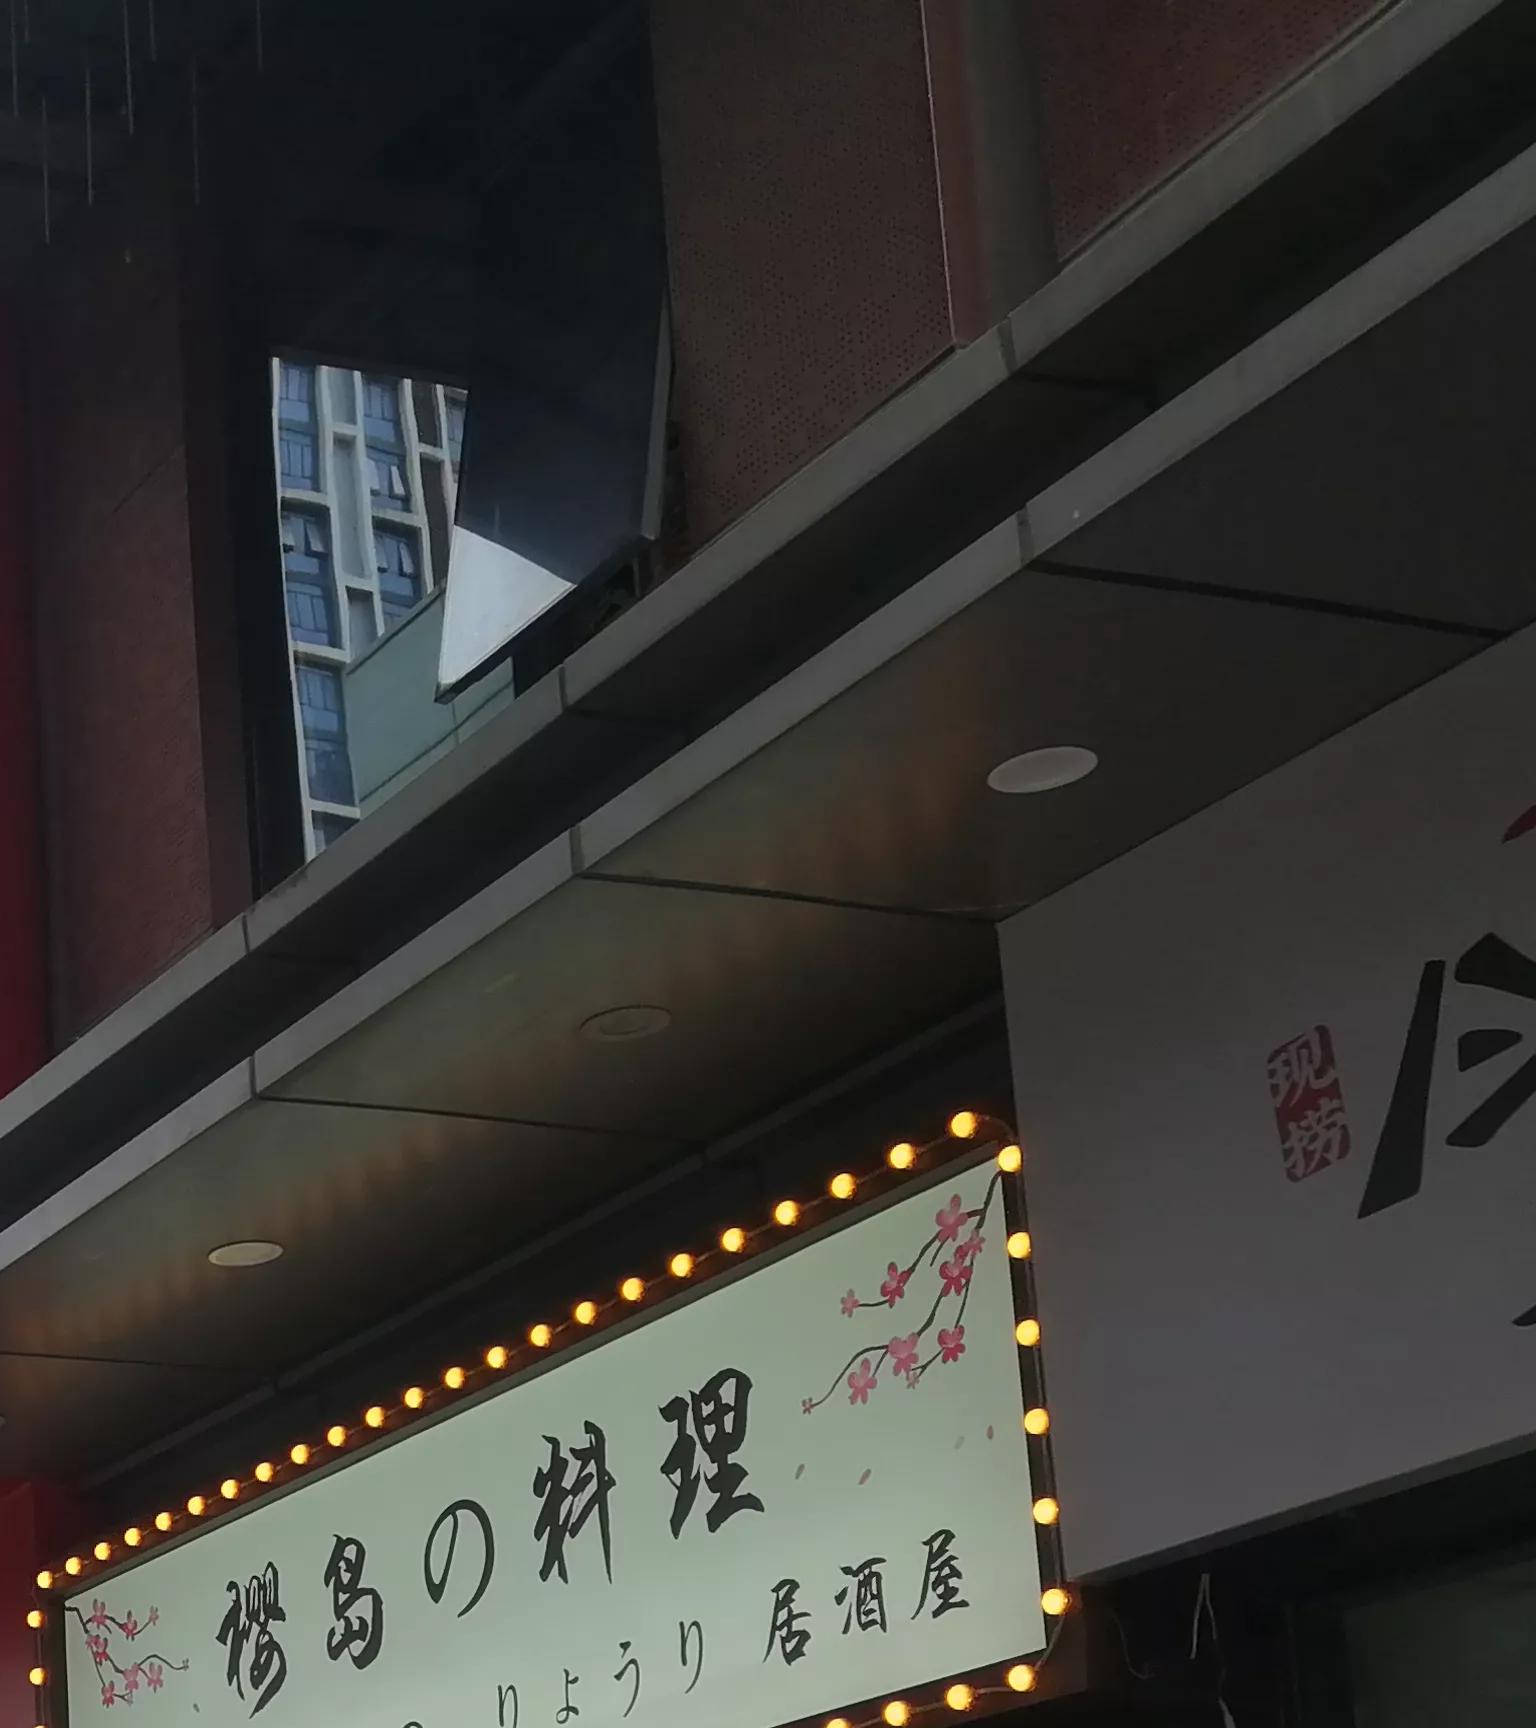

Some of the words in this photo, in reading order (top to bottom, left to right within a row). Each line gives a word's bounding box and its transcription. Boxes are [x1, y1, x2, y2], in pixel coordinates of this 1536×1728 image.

[1269, 1028, 1348, 1180] 现捞
[762, 1528, 971, 1668] 居酒屋
